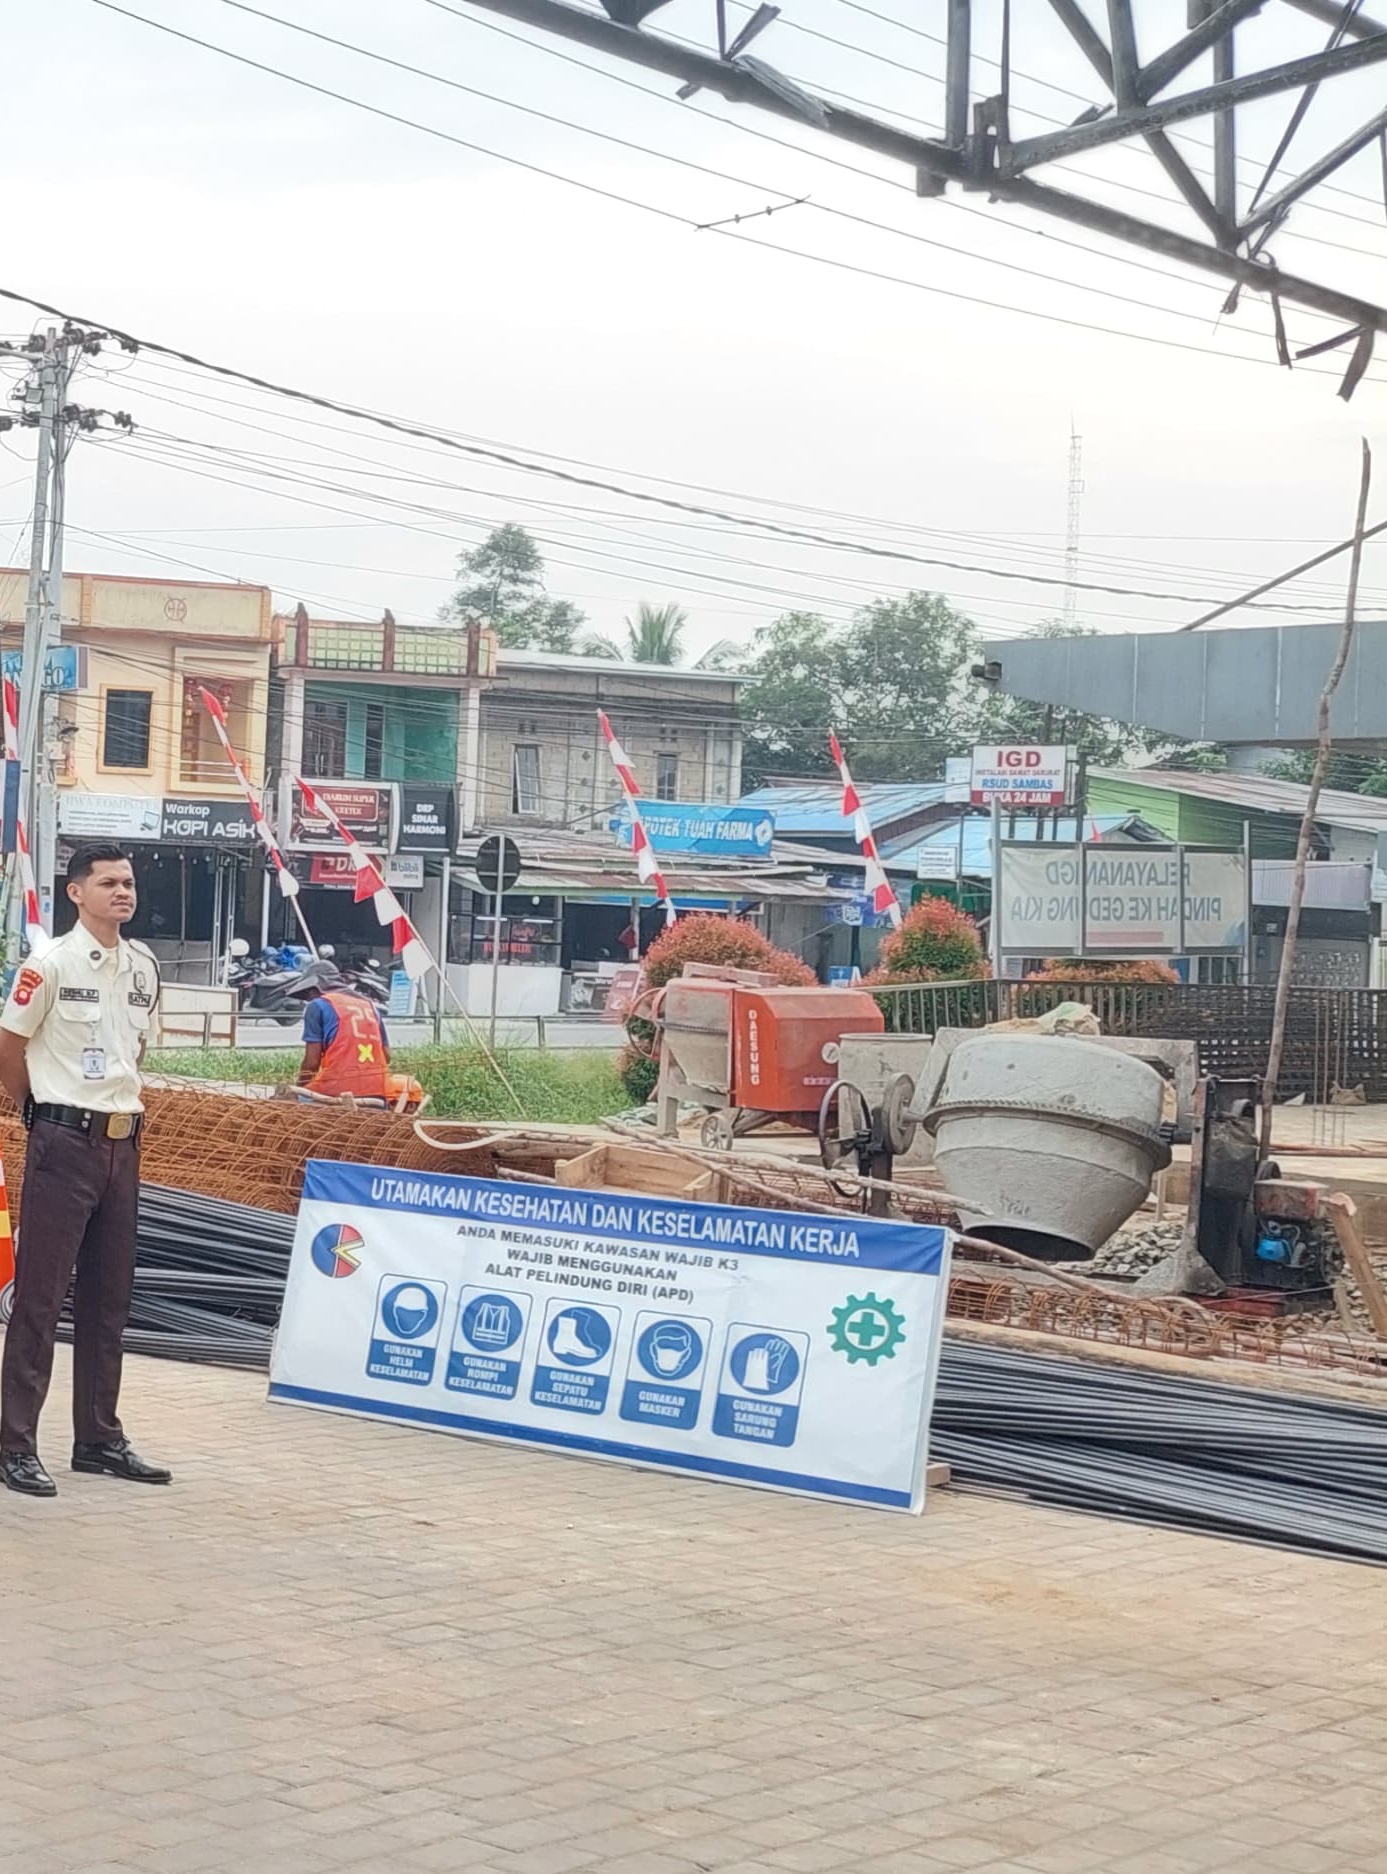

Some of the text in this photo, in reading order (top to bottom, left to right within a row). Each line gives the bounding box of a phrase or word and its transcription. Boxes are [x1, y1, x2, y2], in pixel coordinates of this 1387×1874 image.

[997, 751, 1041, 767] IGD
[982, 779, 1053, 789] RSUD SAMBAS
[1013, 792, 1028, 803] 24
[1029, 793, 1052, 803] JAM
[165, 803, 210, 817] Warkop
[411, 814, 439, 823] SINAR
[163, 819, 256, 839] KOPI ASIK
[403, 824, 446, 835] HARMONI
[641, 815, 753, 841] POTEK TUAH FARMA
[748, 1009, 760, 1085] DAESUNG
[371, 1178, 860, 1258] UTAMAKAN KESEHATAN DAN KESELAMATAN KERJA
[457, 1225, 739, 1271] ANDA MEMASUKI KAWASAN WAJIB K3
[507, 1248, 677, 1281] WAJIB MENGGUNAKAN
[485, 1263, 694, 1305] ALAT PELINDUNG DIRI (APD)
[383, 1343, 424, 1358] GUNAKAN
[389, 1356, 414, 1368] HELM
[463, 1356, 507, 1372] GUNAKAN
[370, 1364, 430, 1381] KESELAMATAN
[467, 1368, 499, 1382] ROMPI
[550, 1370, 595, 1386] GUNAKAN
[448, 1376, 514, 1395] KESELAMATAN
[552, 1382, 589, 1397] SEPATU
[534, 1391, 602, 1411] KESELAMATAN
[638, 1391, 686, 1407] GUNAKAN
[639, 1402, 680, 1418] MASKER
[732, 1399, 783, 1417] GUNAKAN
[734, 1412, 777, 1428] SARUNG
[733, 1423, 775, 1440] TANGAN
